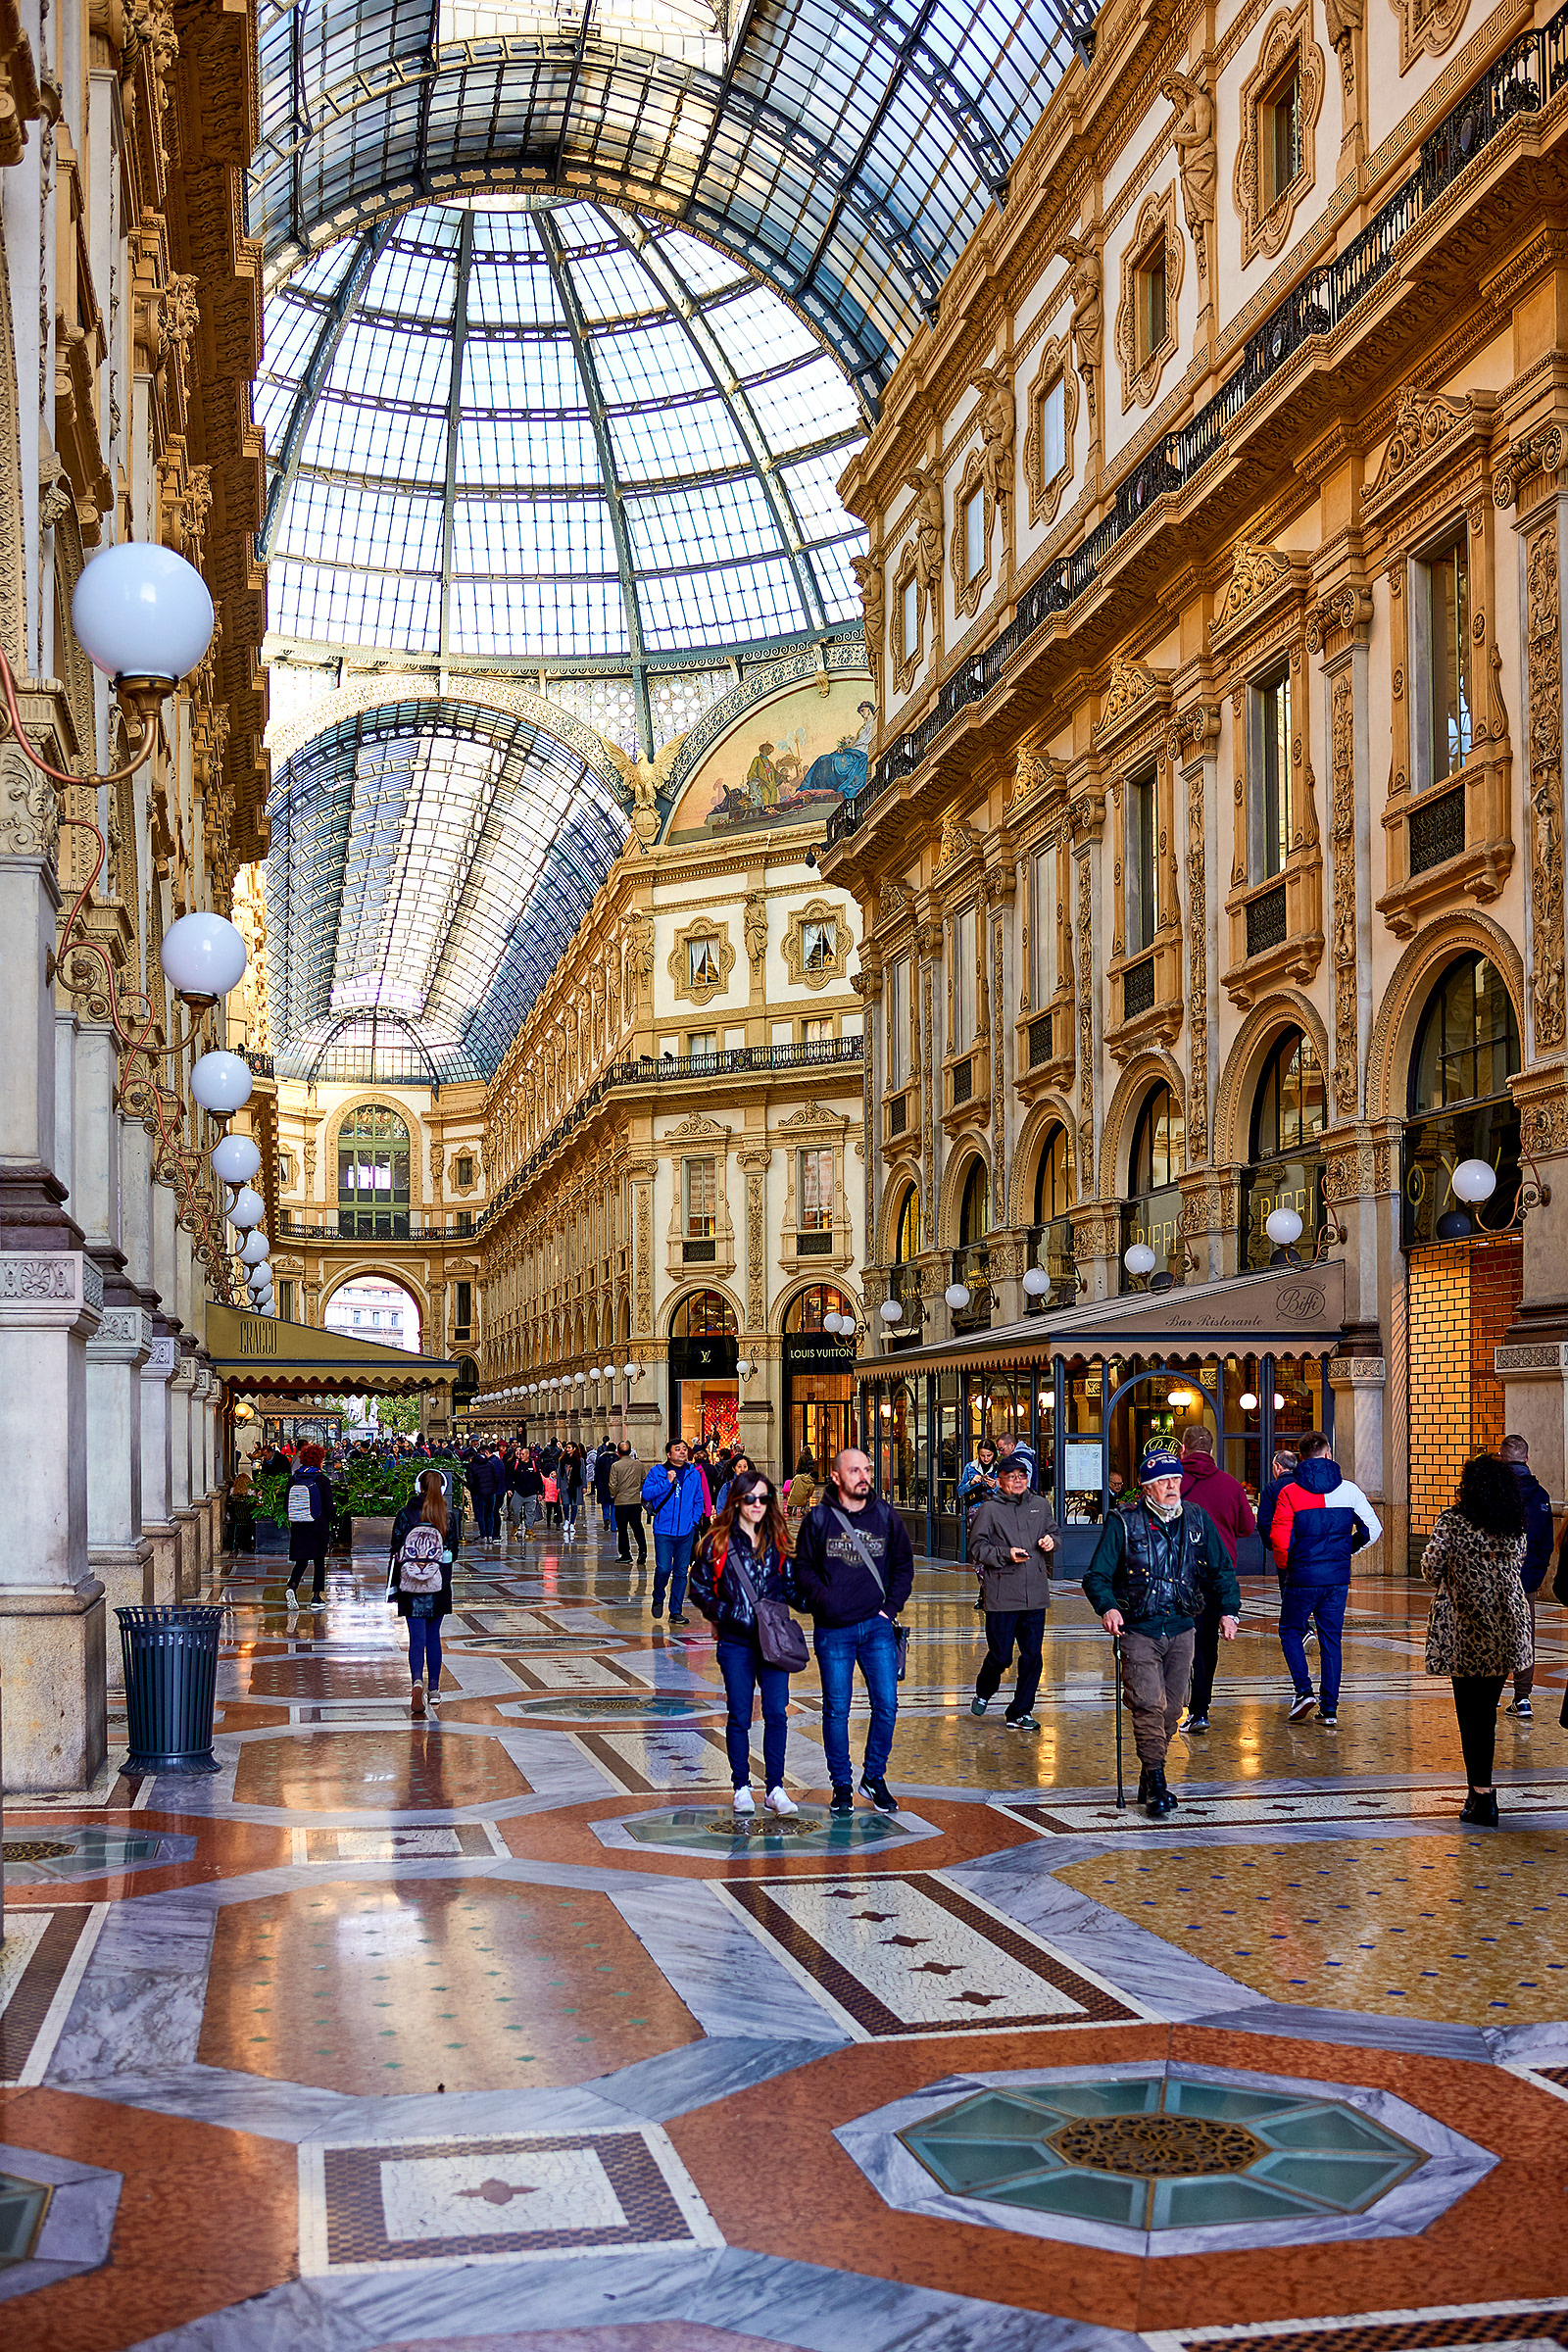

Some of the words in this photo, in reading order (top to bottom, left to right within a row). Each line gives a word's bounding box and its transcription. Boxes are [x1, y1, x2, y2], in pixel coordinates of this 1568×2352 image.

[1282, 1288, 1319, 1317] Biffi
[1165, 1315, 1193, 1326] Bar
[1197, 1314, 1264, 1326] Ristorante
[240, 1320, 276, 1354] CRACCO
[791, 1348, 814, 1359] LOUIS
[816, 1348, 854, 1358] VUITTON
